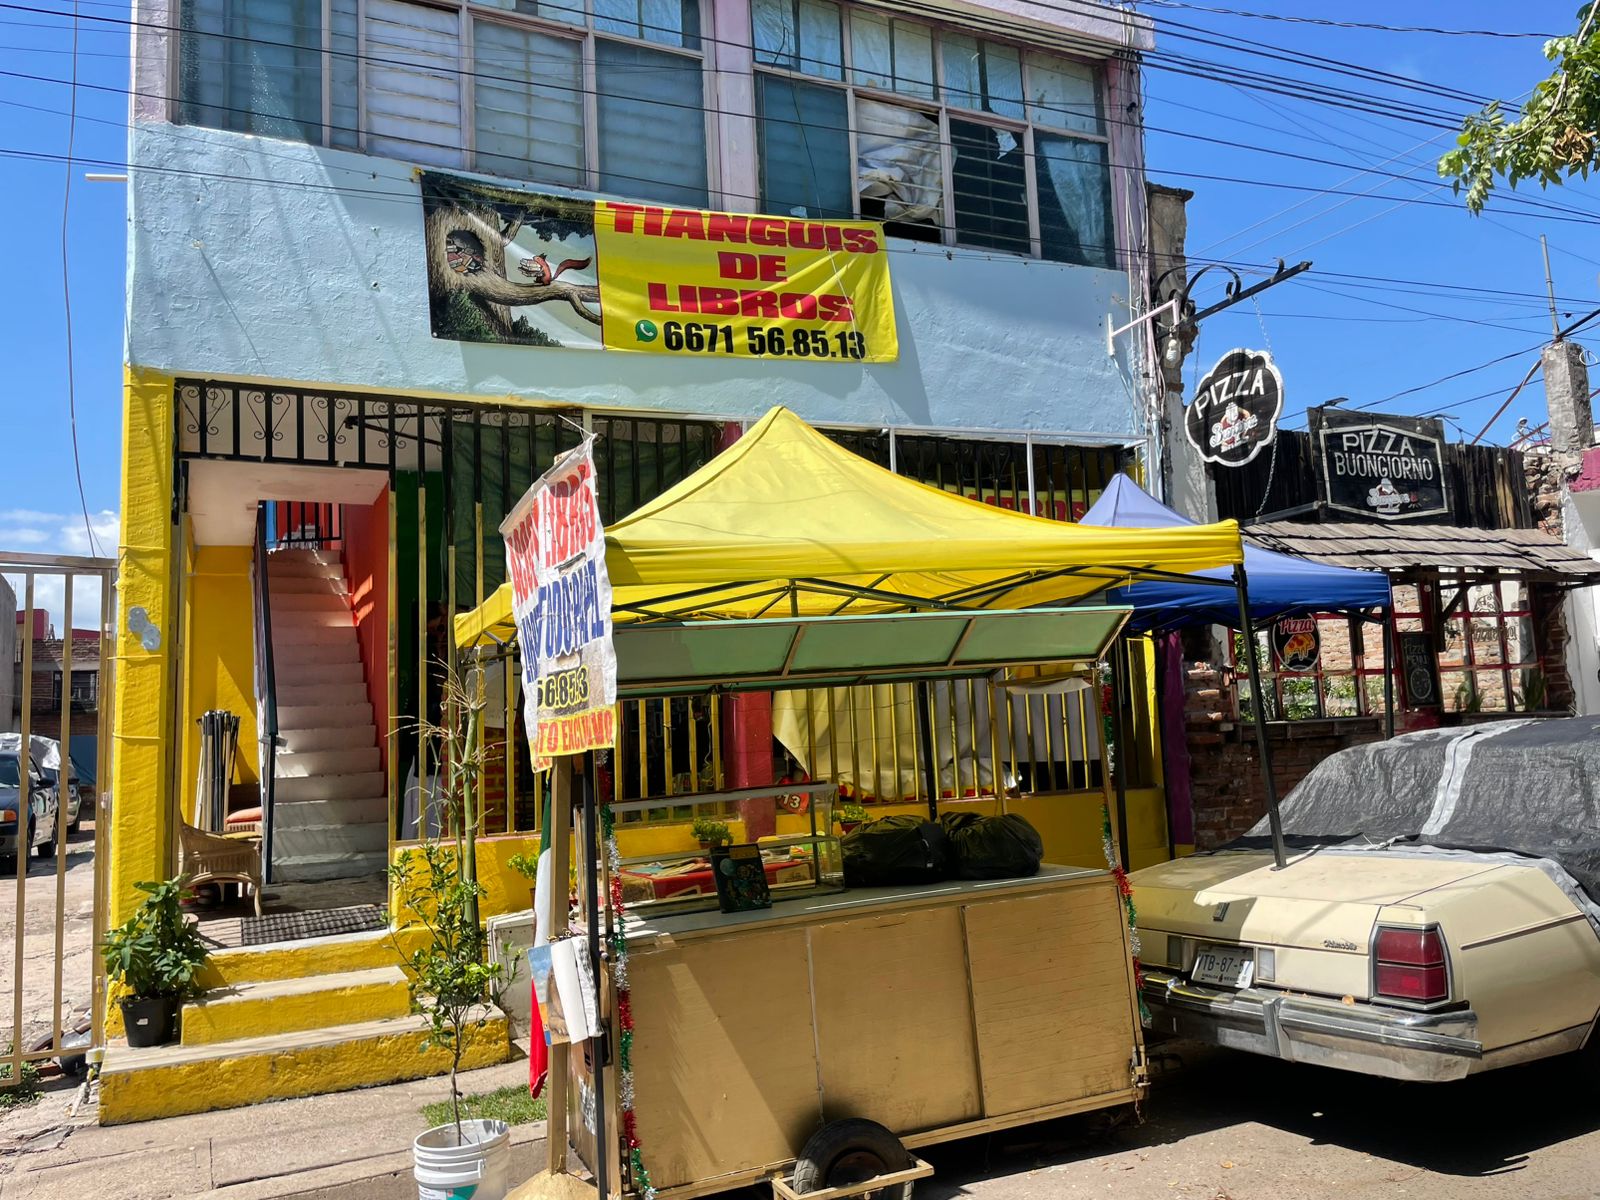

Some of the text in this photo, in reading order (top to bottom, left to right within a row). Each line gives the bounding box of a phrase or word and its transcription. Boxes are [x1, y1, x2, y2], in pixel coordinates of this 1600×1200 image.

[606, 201, 879, 254] TIANGUIS
[717, 251, 788, 283] DE
[647, 282, 855, 323] LIBROS
[663, 321, 866, 360] 6671 56.85.13
[1194, 369, 1265, 420] PIZZA
[1342, 430, 1415, 457] PIZZA
[1334, 451, 1433, 481] BUONGIORNO
[1280, 617, 1315, 635] Pizza
